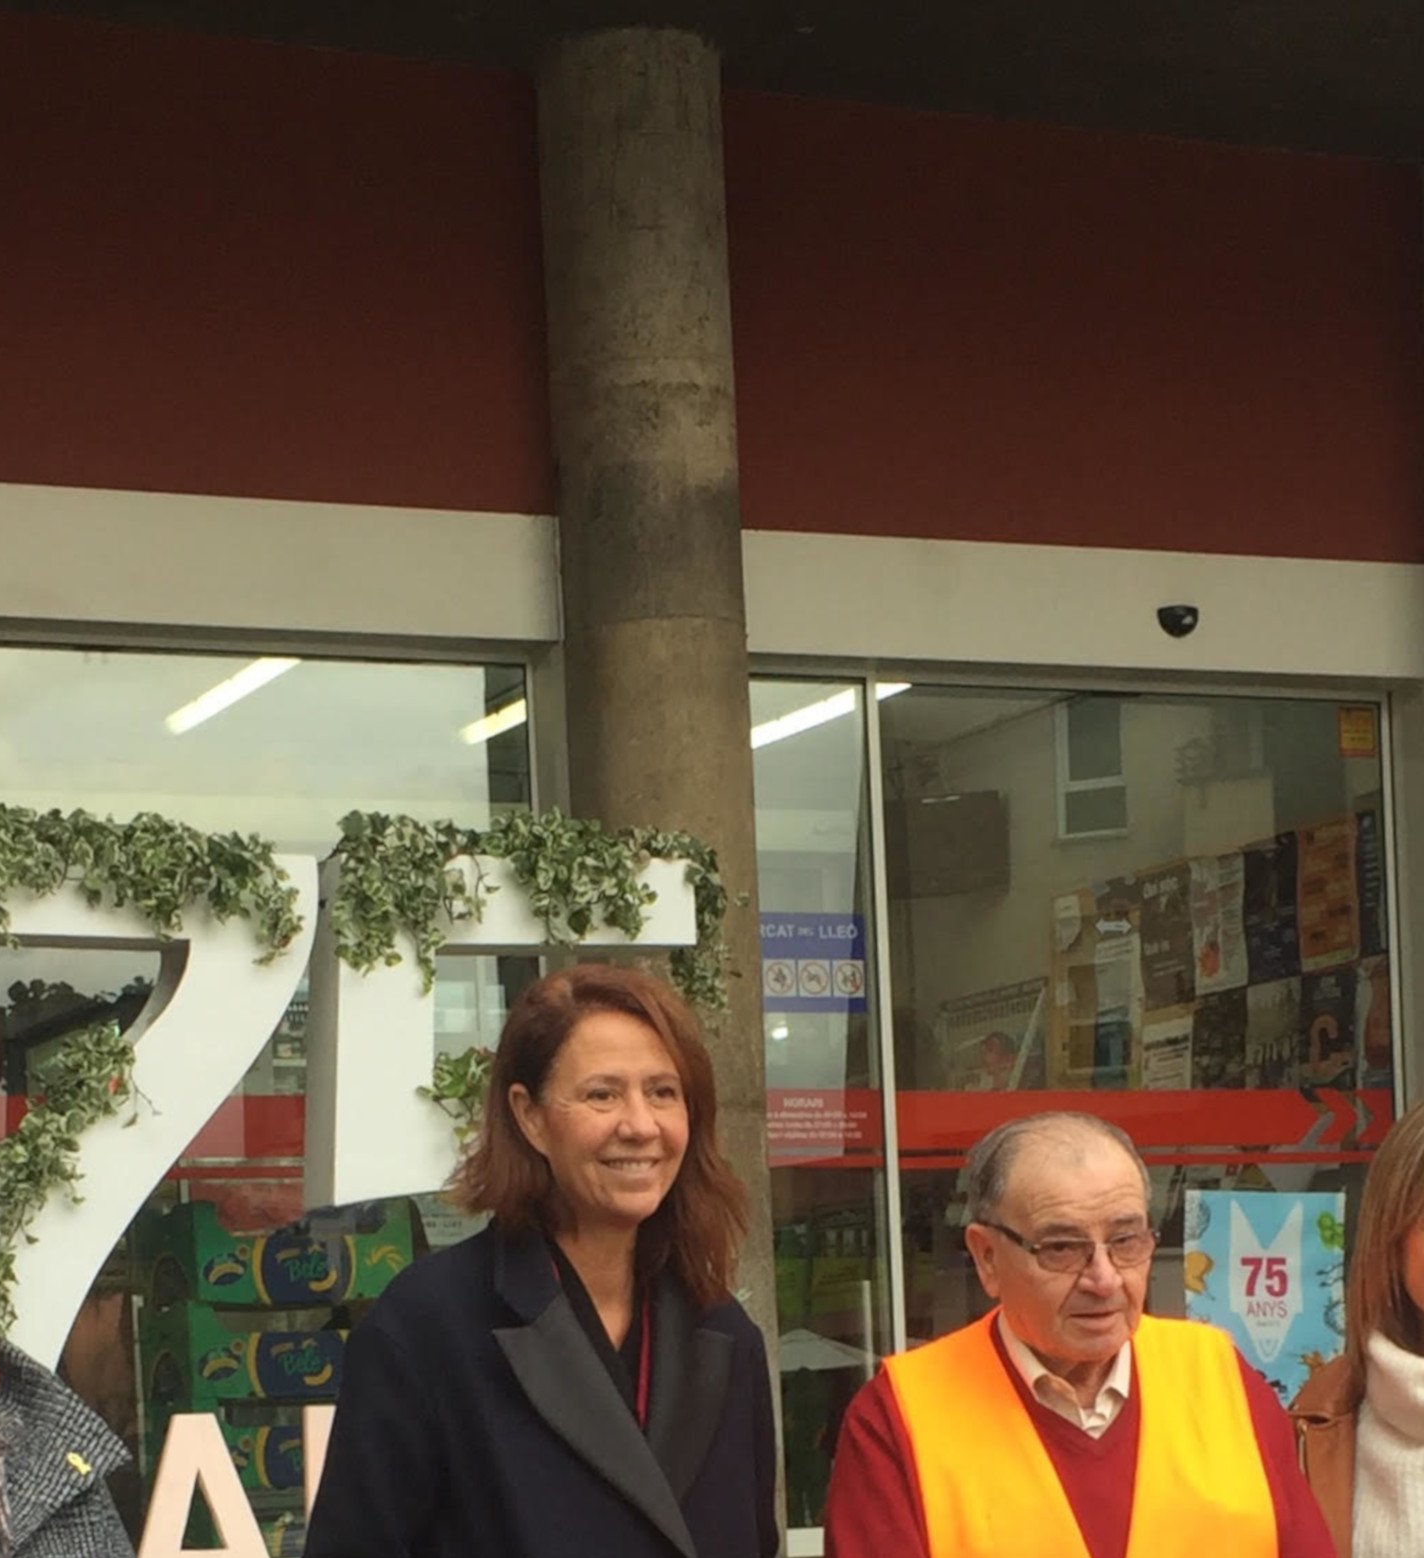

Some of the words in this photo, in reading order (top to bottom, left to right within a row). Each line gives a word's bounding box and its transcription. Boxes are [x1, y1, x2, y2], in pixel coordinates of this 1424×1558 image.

[818, 922, 858, 940] LLEÓ
[1241, 1256, 1289, 1298] 75
[1245, 1300, 1289, 1319] ANYS
